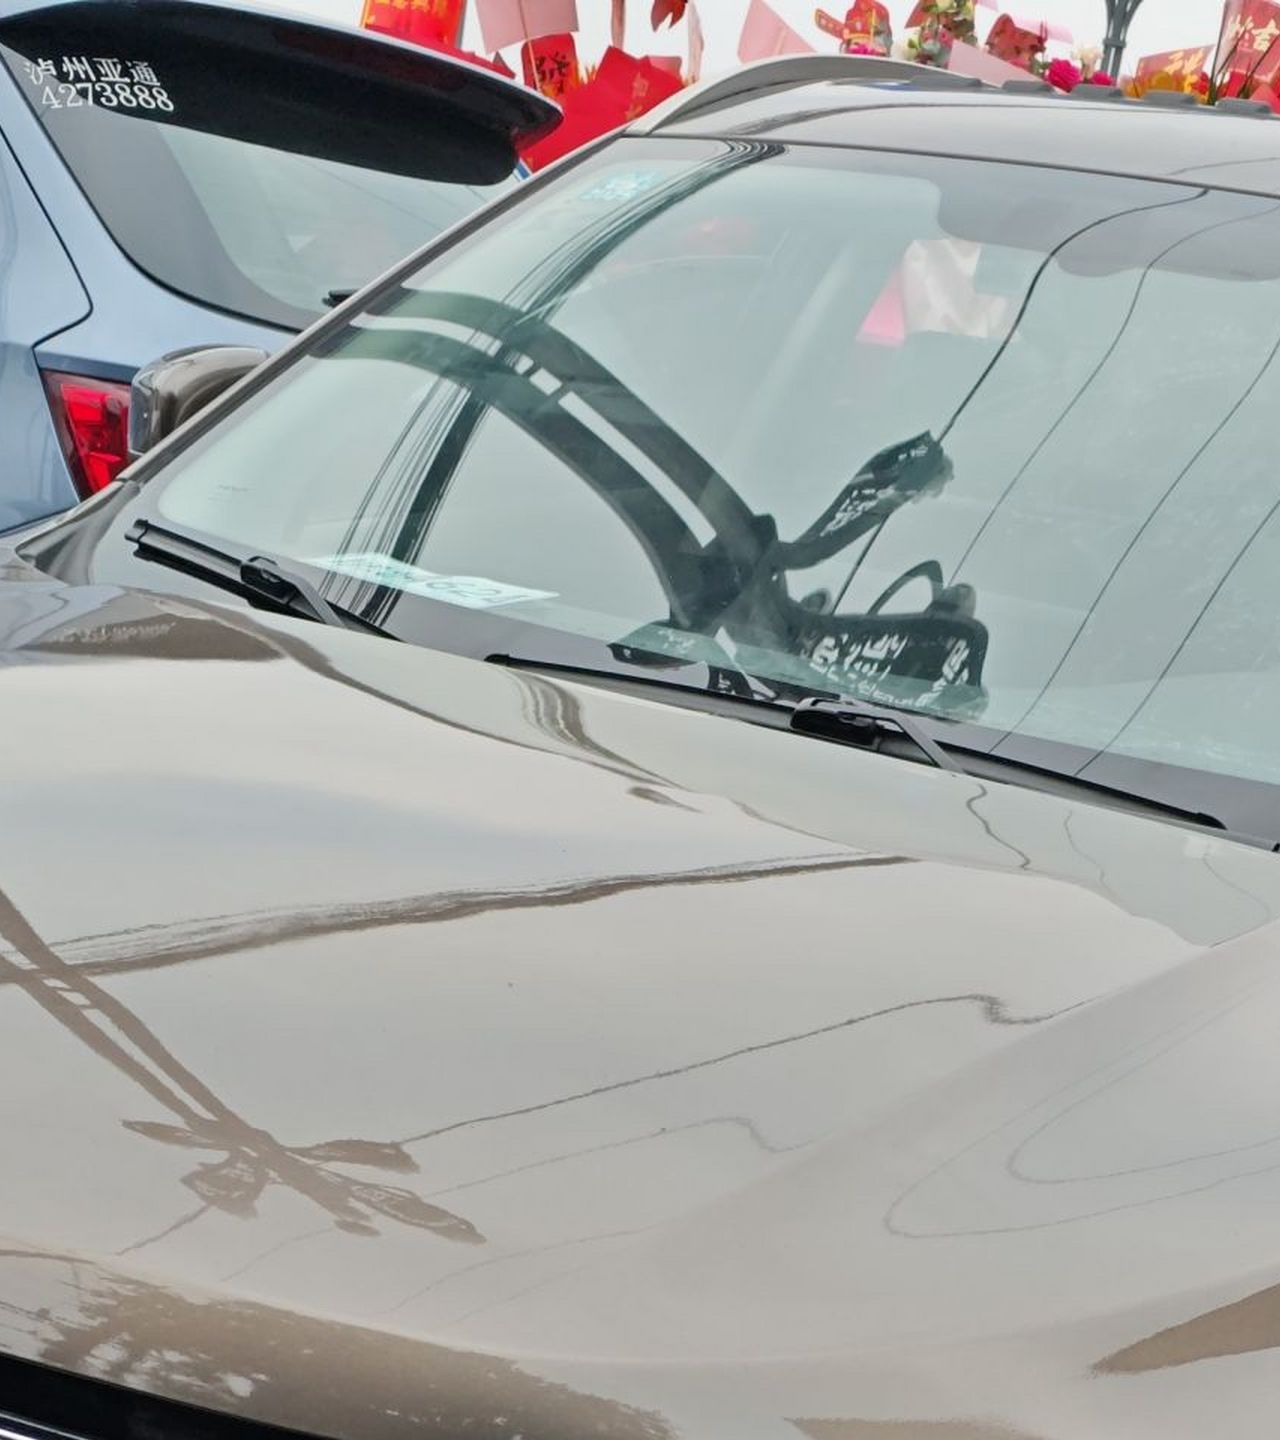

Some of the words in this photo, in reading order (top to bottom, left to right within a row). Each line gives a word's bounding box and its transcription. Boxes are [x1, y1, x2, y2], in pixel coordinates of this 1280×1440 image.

[23, 56, 161, 86] 泸州亚通
[42, 82, 174, 112] 4273888
